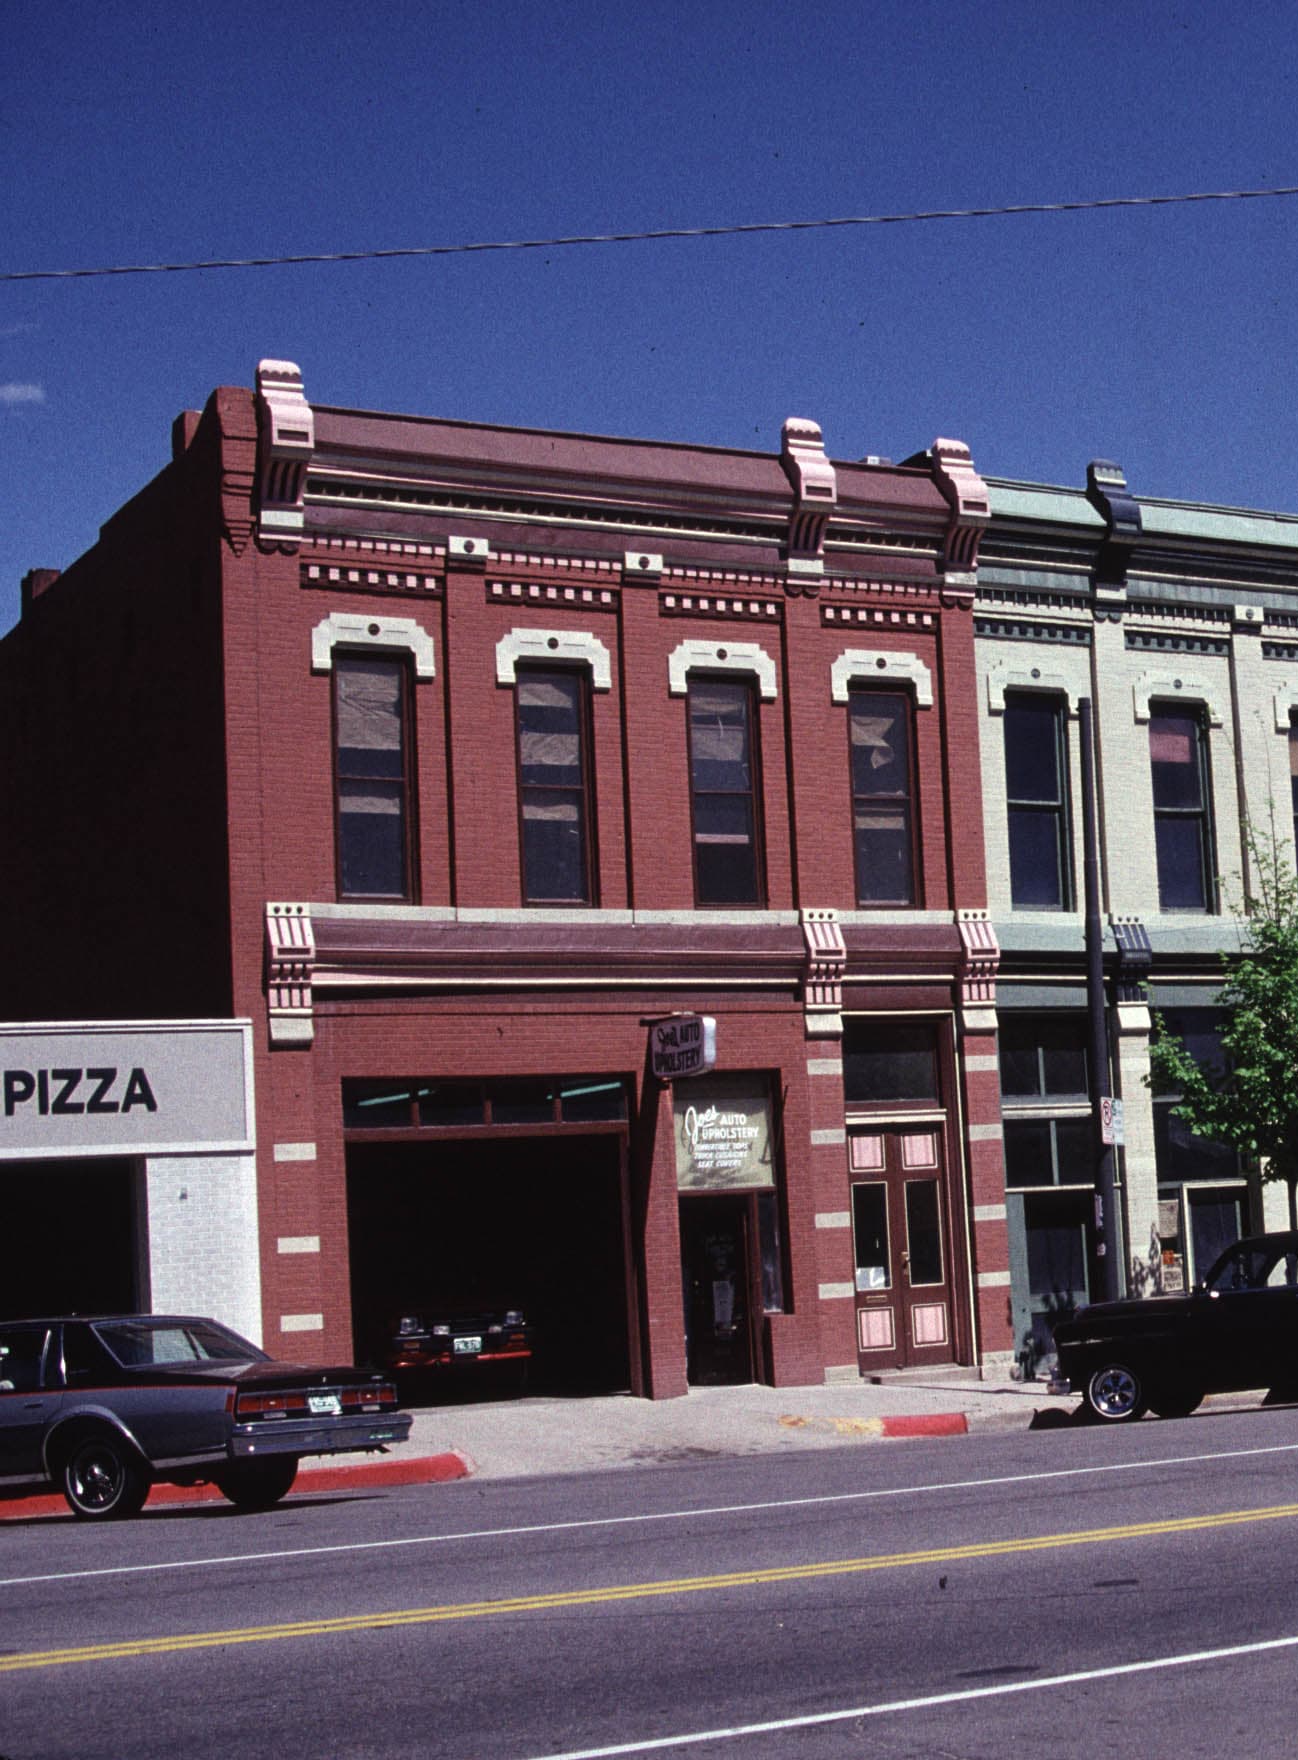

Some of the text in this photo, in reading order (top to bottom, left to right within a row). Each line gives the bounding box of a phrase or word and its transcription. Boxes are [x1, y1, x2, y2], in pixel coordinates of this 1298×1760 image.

[680, 1022, 700, 1042] AUTO
[4, 1068, 157, 1116] PIZZA
[720, 1113, 747, 1126] AUTO
[702, 1127, 760, 1140] UPHOLSTERY
